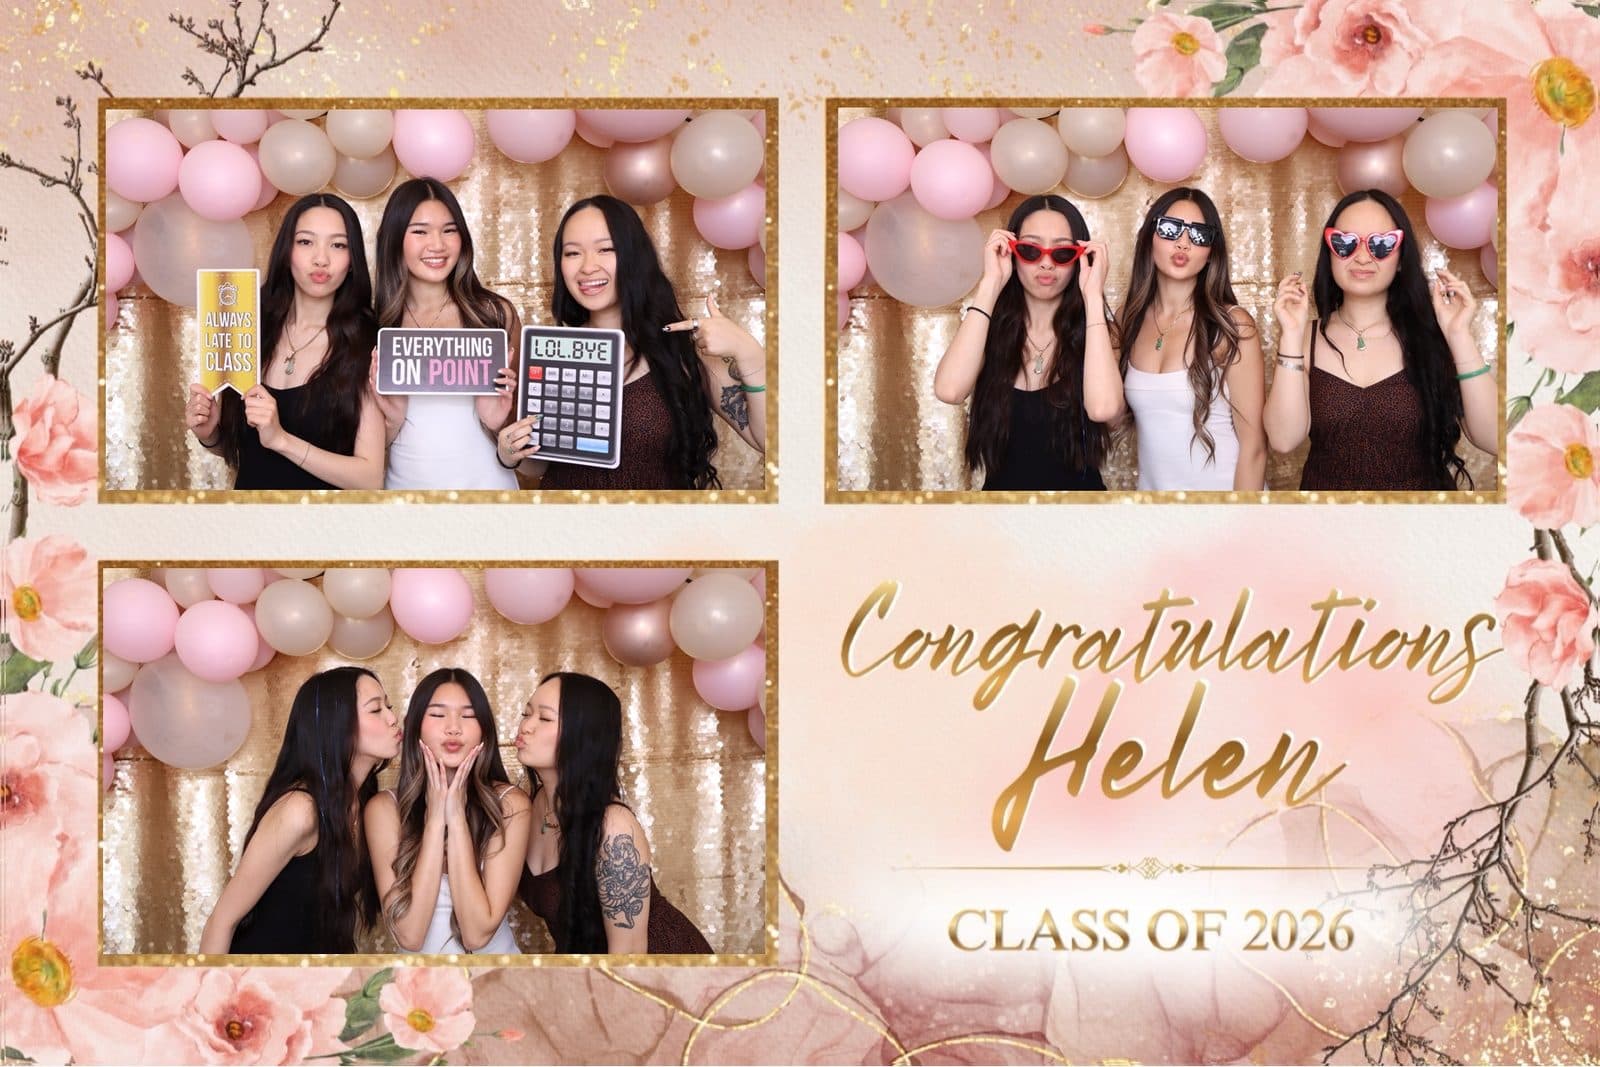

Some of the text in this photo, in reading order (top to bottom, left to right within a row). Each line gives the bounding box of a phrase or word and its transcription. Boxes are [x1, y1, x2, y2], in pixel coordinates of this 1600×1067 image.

[206, 311, 252, 328] ALWAYS
[205, 333, 252, 349] LATE TO
[392, 336, 493, 357] EVERYTHING
[535, 339, 607, 361] LOL.BYE
[206, 352, 252, 372] CLASS
[391, 358, 493, 386] ON POINT
